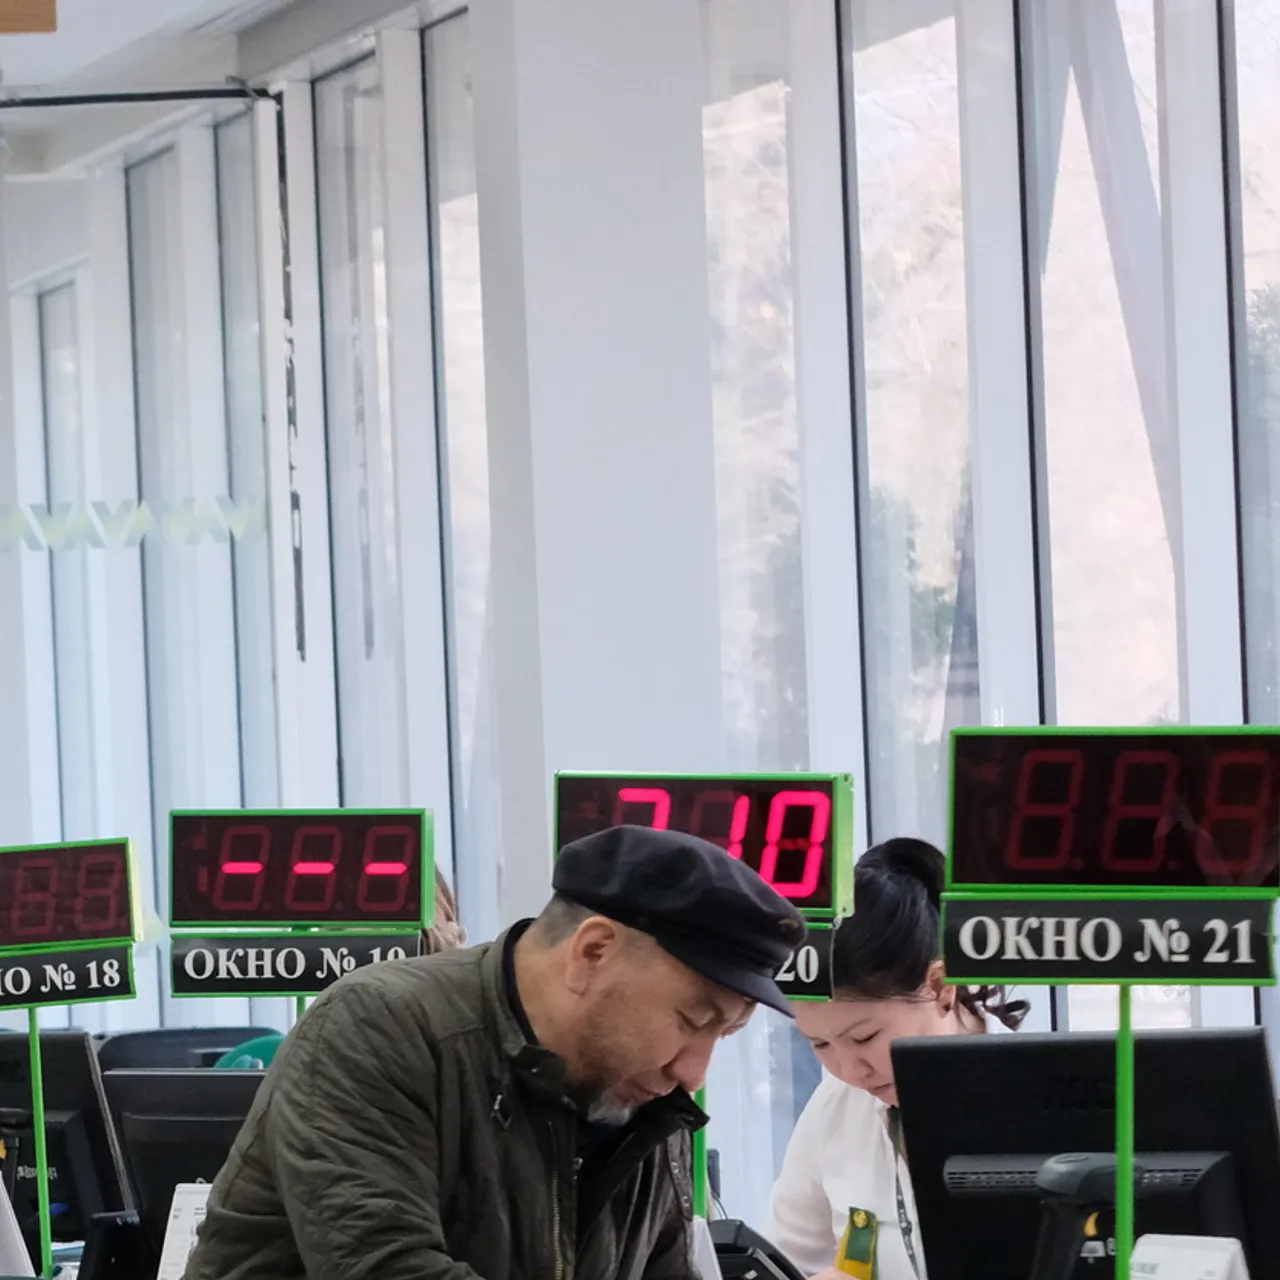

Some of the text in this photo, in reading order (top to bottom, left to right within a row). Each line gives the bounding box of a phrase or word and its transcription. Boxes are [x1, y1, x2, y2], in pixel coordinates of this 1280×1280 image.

[958, 915, 1256, 963] ОКНО № 21
[40, 962, 77, 993] №
[86, 958, 122, 989] 18
[183, 946, 307, 980] ОКНО
[315, 946, 356, 979] №
